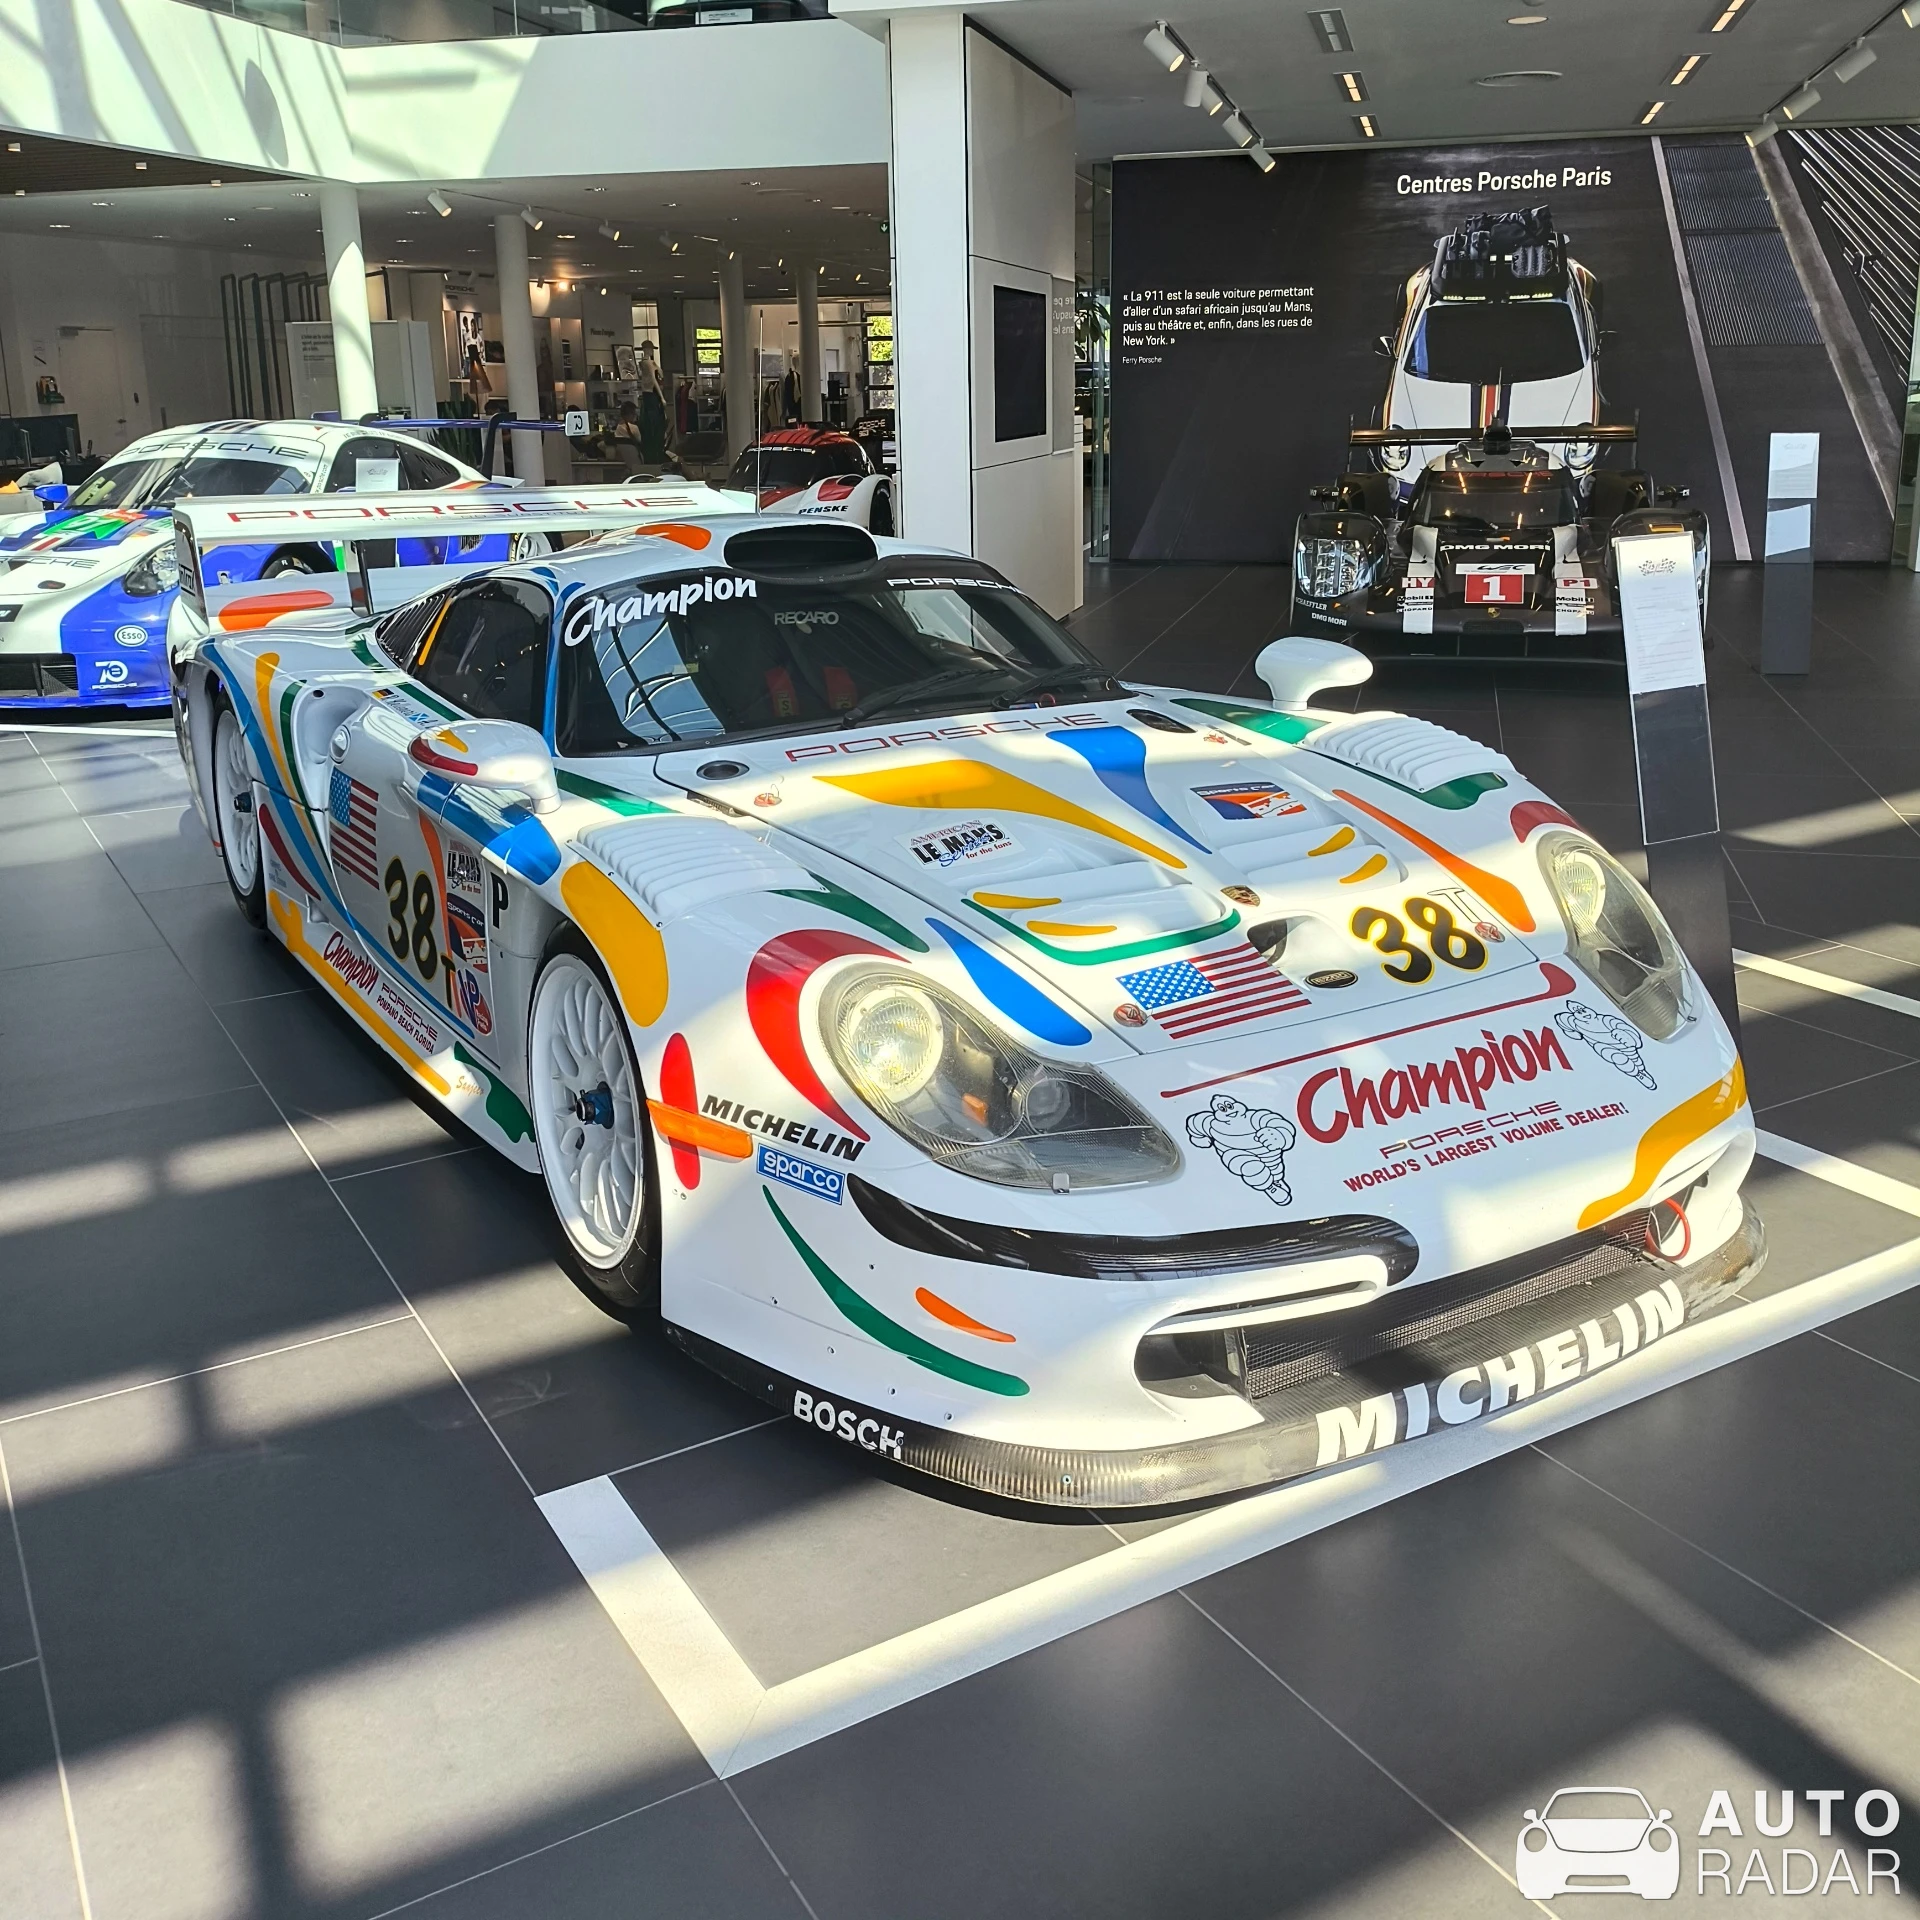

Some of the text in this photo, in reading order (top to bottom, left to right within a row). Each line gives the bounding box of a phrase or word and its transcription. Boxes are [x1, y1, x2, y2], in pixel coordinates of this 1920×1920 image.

[1397, 166, 1612, 195] Centres Porsche Paris
[1131, 290, 1142, 302] La
[1144, 290, 1163, 302] 911
[1166, 291, 1182, 301] est
[1184, 290, 1192, 300] la
[1195, 288, 1220, 300] seule
[1222, 288, 1256, 299] voiture
[1258, 286, 1314, 300] permettant
[1123, 301, 1313, 317] d'aller d'un safari africain jusqu'au Mans,
[1123, 316, 1313, 334] puis au théâtre et, enfin, dans les rues de
[1123, 335, 1144, 347] New
[1145, 334, 1168, 346] York.
[1122, 356, 1162, 365] Ferry Porsche
[119, 441, 310, 460] PORSCHE
[227, 496, 698, 523] PORSCHE
[799, 505, 849, 515] PENSKE
[1440, 544, 1551, 552] DMG MORI
[1402, 578, 1432, 588] HY
[1482, 576, 1506, 601] 1
[563, 575, 758, 648] Champion
[774, 610, 839, 626] RECARO
[1312, 612, 1348, 627] DMG MORI
[786, 713, 1109, 763] PORSCHE
[1196, 786, 1248, 796] Sports
[910, 824, 1005, 865] LE MANS
[911, 820, 983, 846] AMERICAN
[939, 832, 990, 867] Series
[966, 841, 1012, 860] for the fans
[447, 901, 484, 927] Sports Car
[490, 872, 509, 930] P
[384, 855, 456, 1011] 38 T
[1349, 887, 1489, 987] 38 T
[324, 931, 379, 996] Champion
[376, 995, 434, 1055] POMPANO BEACH FLORIDA
[381, 983, 438, 1042] PORSCHE
[1297, 1026, 1574, 1144] Champion
[702, 1094, 866, 1162] MICHELIN
[1379, 1100, 1562, 1160] PORSCHE
[1343, 1102, 1630, 1193] WORLD'S LARGEST VOLUME DEALER!
[764, 1151, 840, 1192] sparco
[1315, 1278, 1687, 1468] MICHELIN
[794, 1390, 905, 1460] BOSCH
